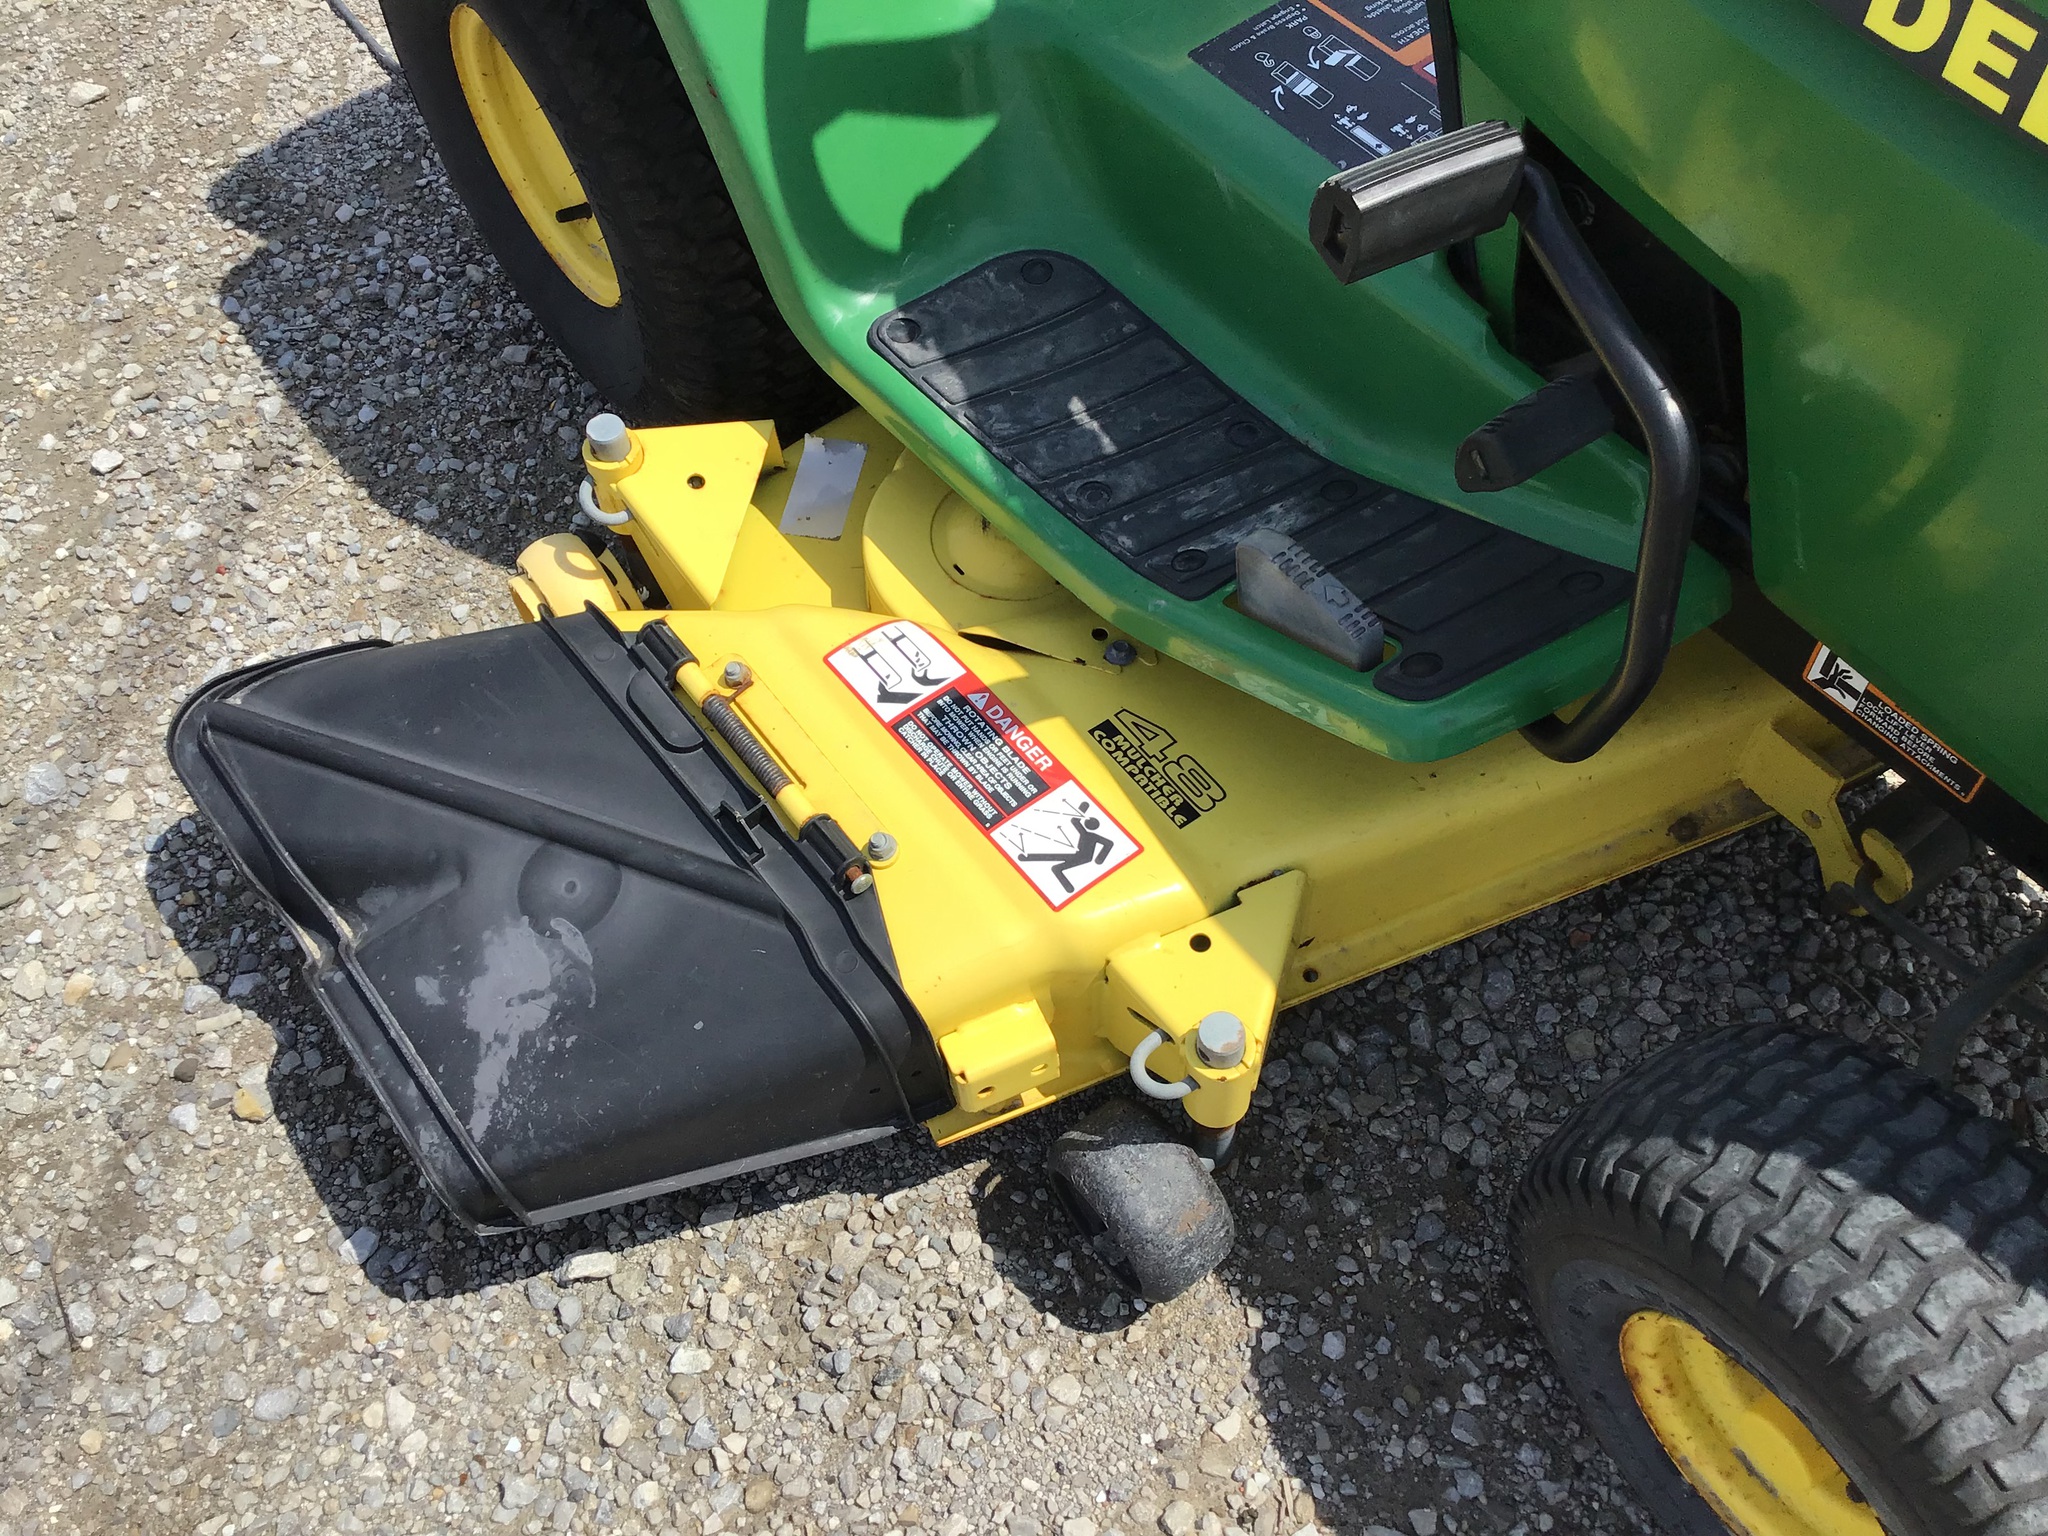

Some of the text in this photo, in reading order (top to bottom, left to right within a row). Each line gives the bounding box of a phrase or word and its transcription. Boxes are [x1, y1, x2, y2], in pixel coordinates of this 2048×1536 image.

[1228, 37, 1250, 51] Clutch
[1252, 5, 1295, 31] Engage Latch
[1255, 23, 1275, 36] Brake
[1273, 9, 1301, 26] Depress
[1285, 14, 1308, 29] PARK
[1390, 23, 1415, 39] across
[1396, 27, 1424, 45] DEATH
[1863, 0, 2048, 146] DE
[897, 727, 923, 752] CATCHER
[925, 757, 945, 776] PLACE
[916, 711, 994, 793] THAT MAY BE THROWN BY BLADE
[922, 707, 943, 728] BEFORE
[959, 747, 978, 765] CLEAR
[973, 762, 990, 777] AREA
[986, 776, 997, 785] OF
[993, 783, 1017, 807] OBJECTS
[935, 699, 950, 713] INTO
[947, 711, 969, 732] MOWER
[966, 731, 984, 748] WHEN
[981, 747, 1003, 768] ENGINE
[1005, 772, 1032, 798] RUNNING
[940, 715, 1013, 789] THROWN OBJECTS
[942, 695, 1038, 794] DO NOT PUT HANDS OR FEET UNDER OR
[961, 704, 1031, 774] ROTATING BLADE
[985, 704, 1054, 771] DANGER
[1113, 708, 1226, 812] 48
[1854, 708, 1961, 791] CHANGING ATTACHMENTS
[1857, 702, 1935, 763] FORWARD BEFORE
[1861, 697, 1932, 753] LOCK LIFT LEVER
[1877, 700, 1958, 765] LOADED SPRING
[901, 723, 993, 819] DISCHARGE CHUTE OR ENTIRE GRASS
[907, 720, 998, 816] DO NOT OPERATE MOWER WITHOUT
[1090, 728, 1187, 825] COMPATIBLE
[1111, 733, 1185, 806] MULCHER
